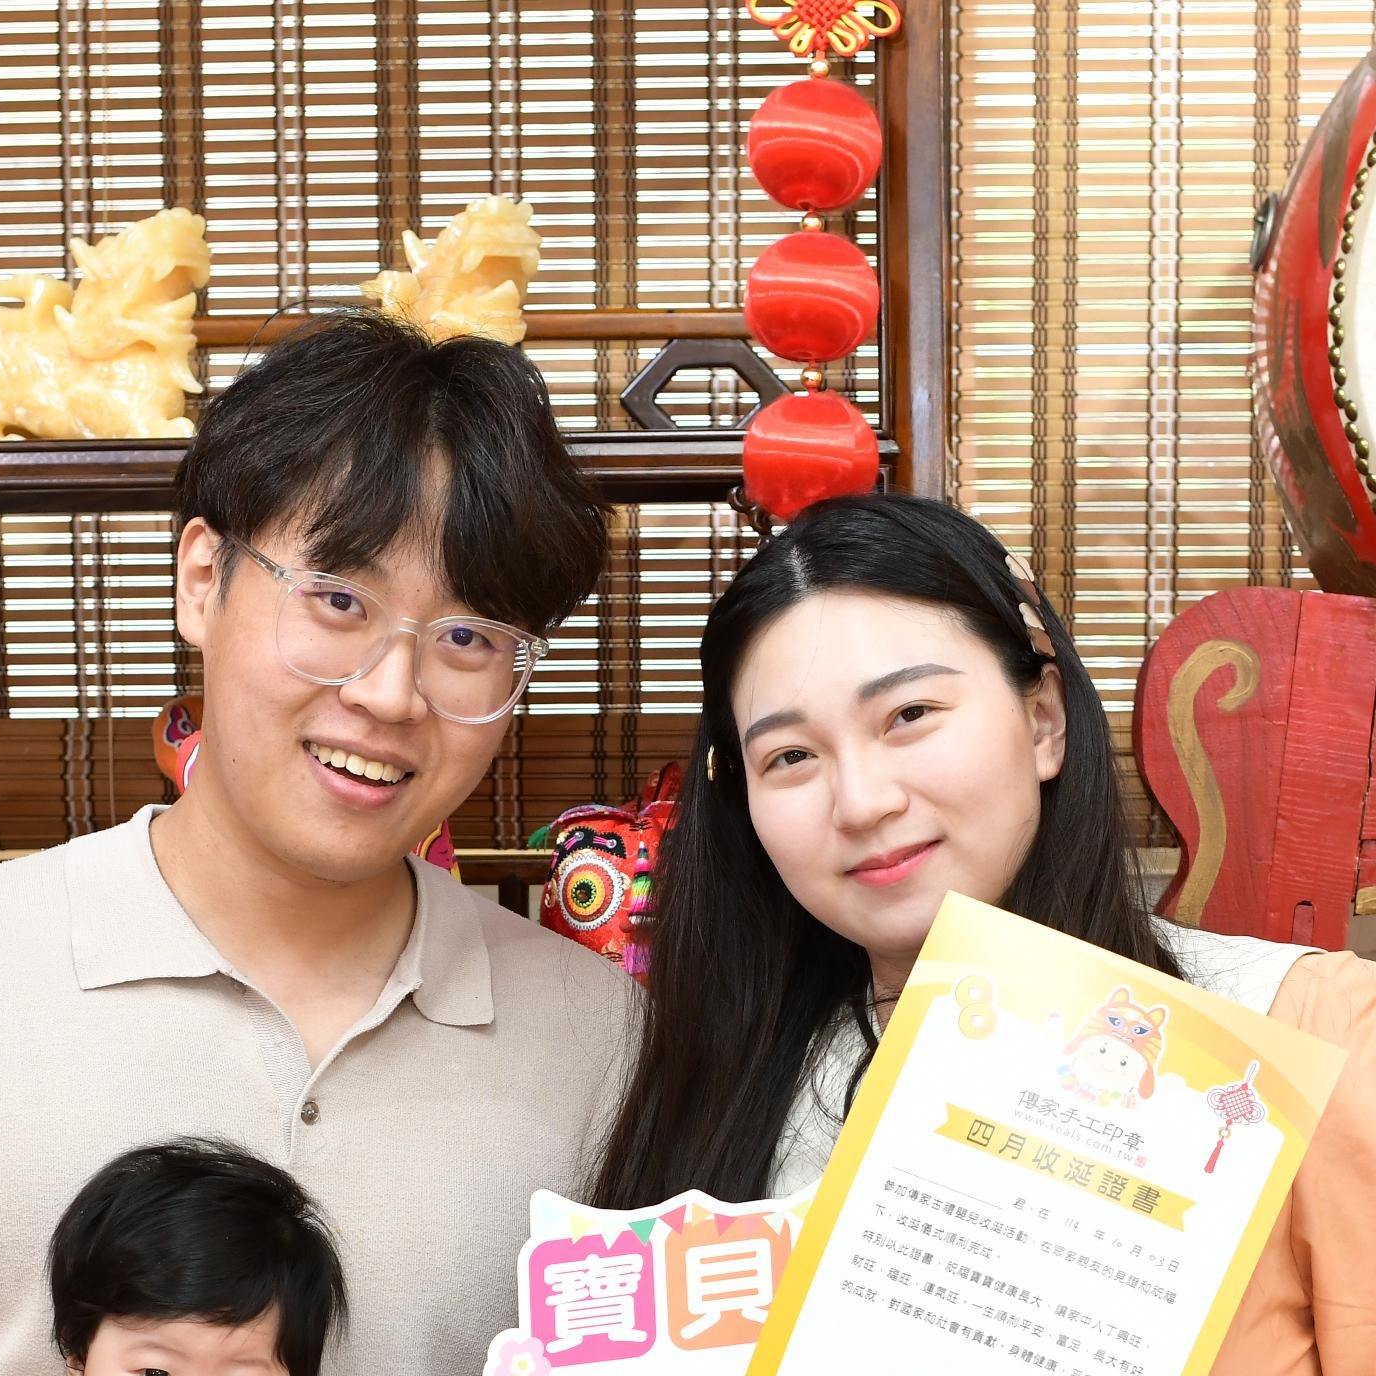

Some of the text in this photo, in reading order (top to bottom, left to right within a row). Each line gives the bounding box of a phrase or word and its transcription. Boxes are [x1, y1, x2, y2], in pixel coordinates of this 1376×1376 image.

[1014, 1109, 1133, 1162] www.seals.com.tw
[1018, 1090, 1145, 1151] 傳家手工印章
[964, 1115, 1164, 1216] 四月收涎證書
[1094, 1229, 1105, 1240] 年
[1129, 1244, 1143, 1258] 月
[1167, 1259, 1180, 1273] 日
[543, 1237, 772, 1354] 寶貝
